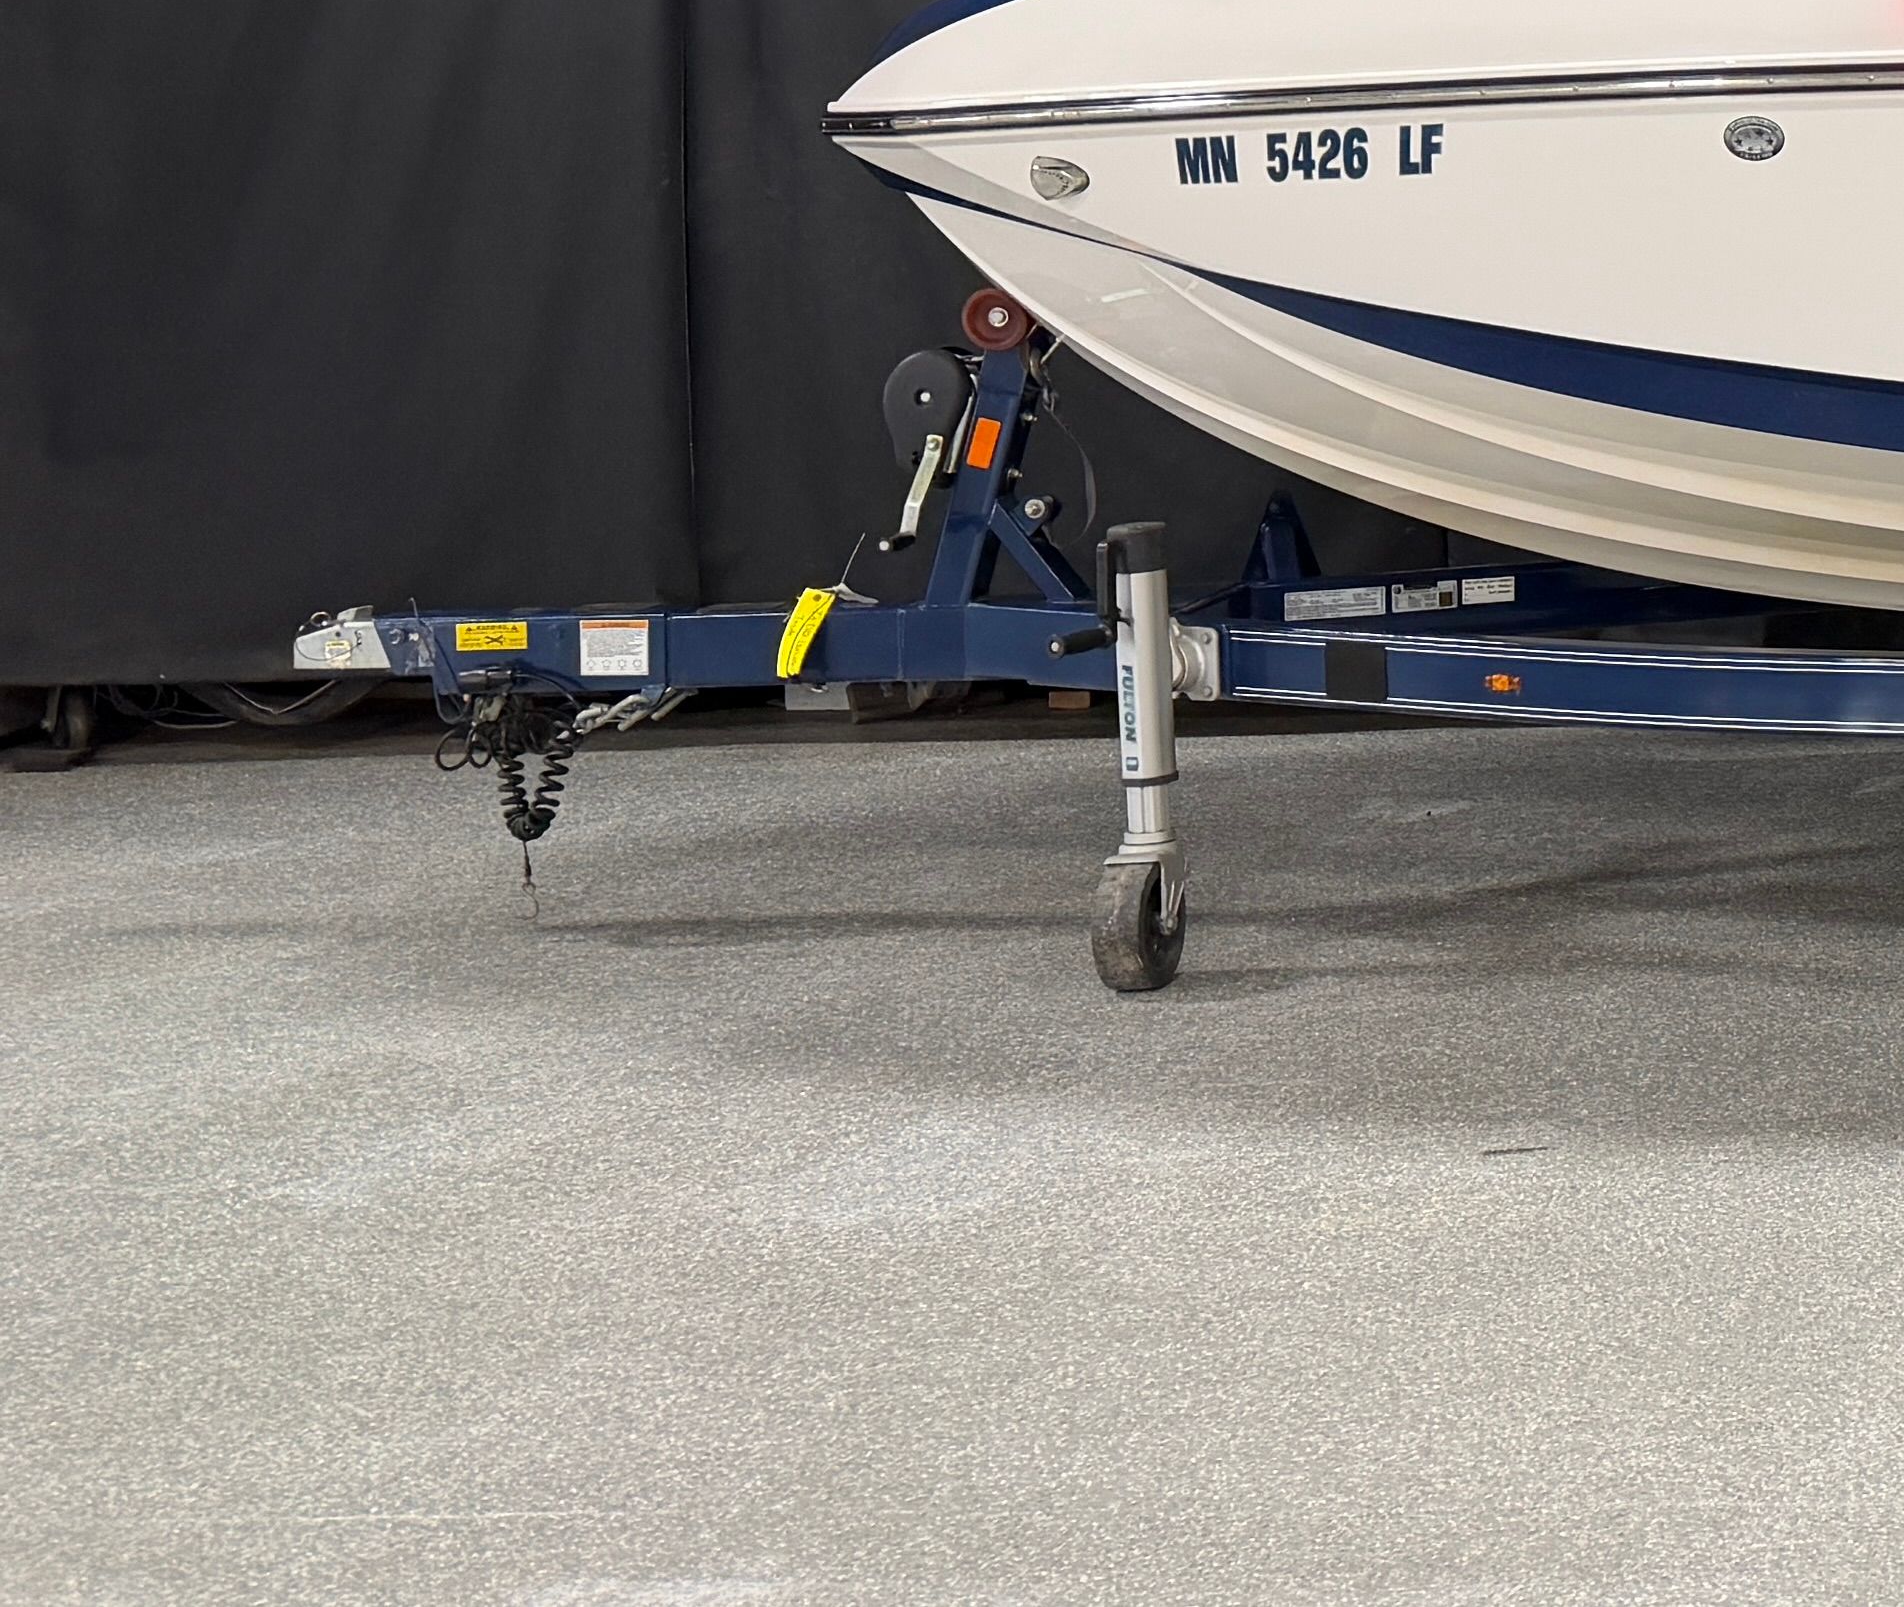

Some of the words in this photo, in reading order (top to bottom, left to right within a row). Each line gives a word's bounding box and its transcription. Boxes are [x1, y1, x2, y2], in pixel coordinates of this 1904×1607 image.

[1175, 135, 1239, 185] MN
[1266, 127, 1369, 183] 5426
[1399, 123, 1444, 176] LF
[1121, 664, 1137, 743] FULTON
